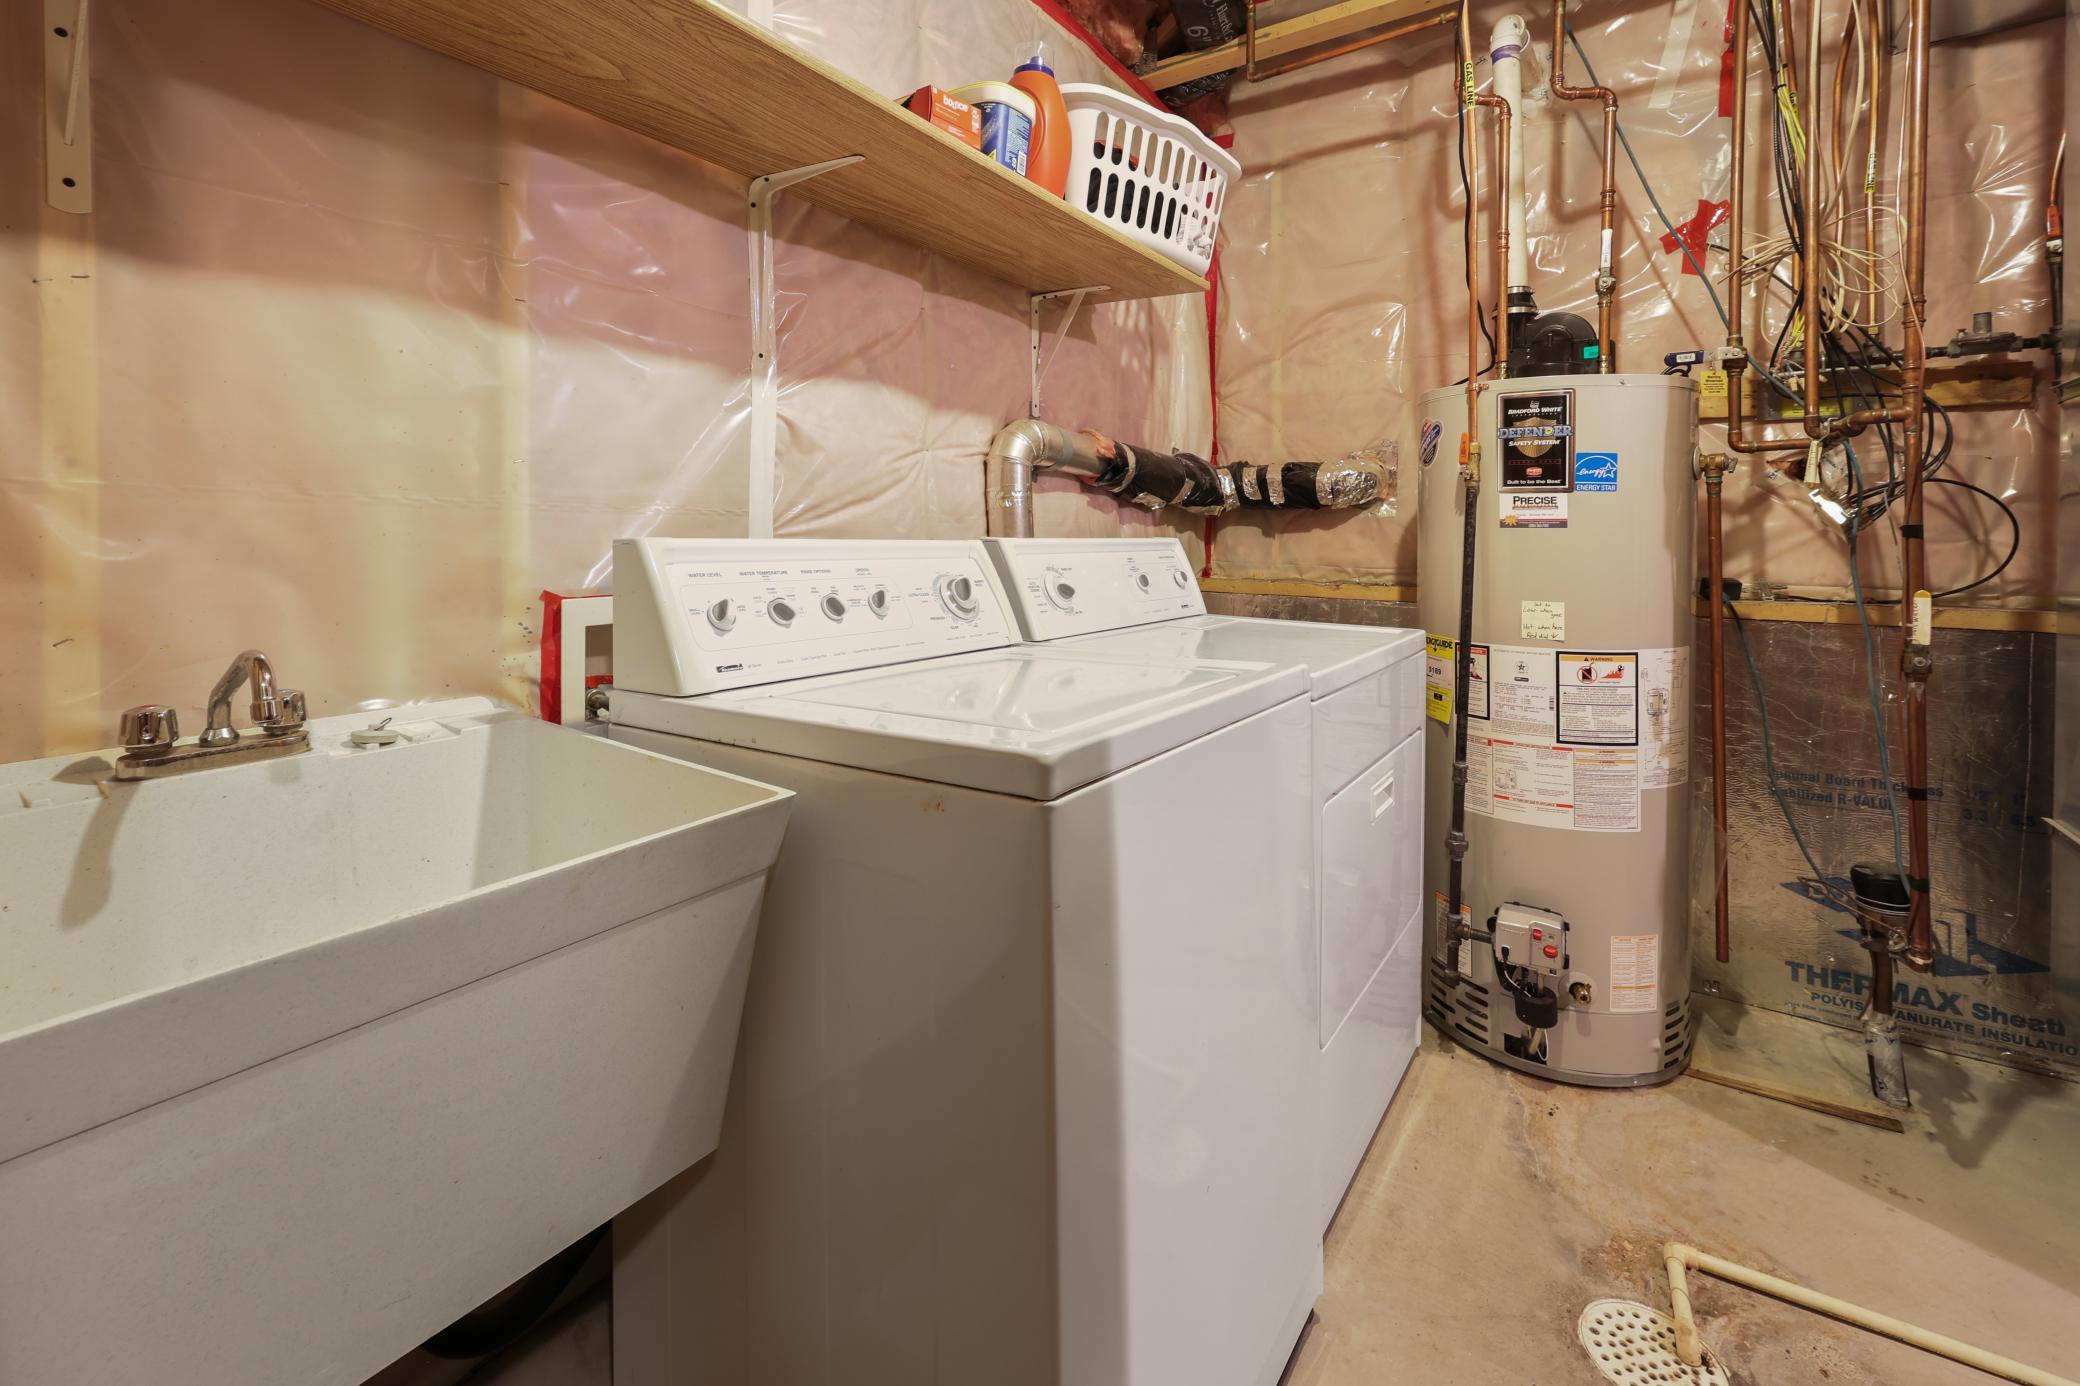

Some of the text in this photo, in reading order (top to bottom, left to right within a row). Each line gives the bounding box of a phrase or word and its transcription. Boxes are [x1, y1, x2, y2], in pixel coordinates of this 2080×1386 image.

[1465, 62, 1475, 108] GAS LINE
[1508, 407, 1540, 415] BRADFORD
[1498, 425, 1573, 439] DEFENDER
[1512, 495, 1558, 505] PRECISE
[1824, 772, 1865, 787] Board
